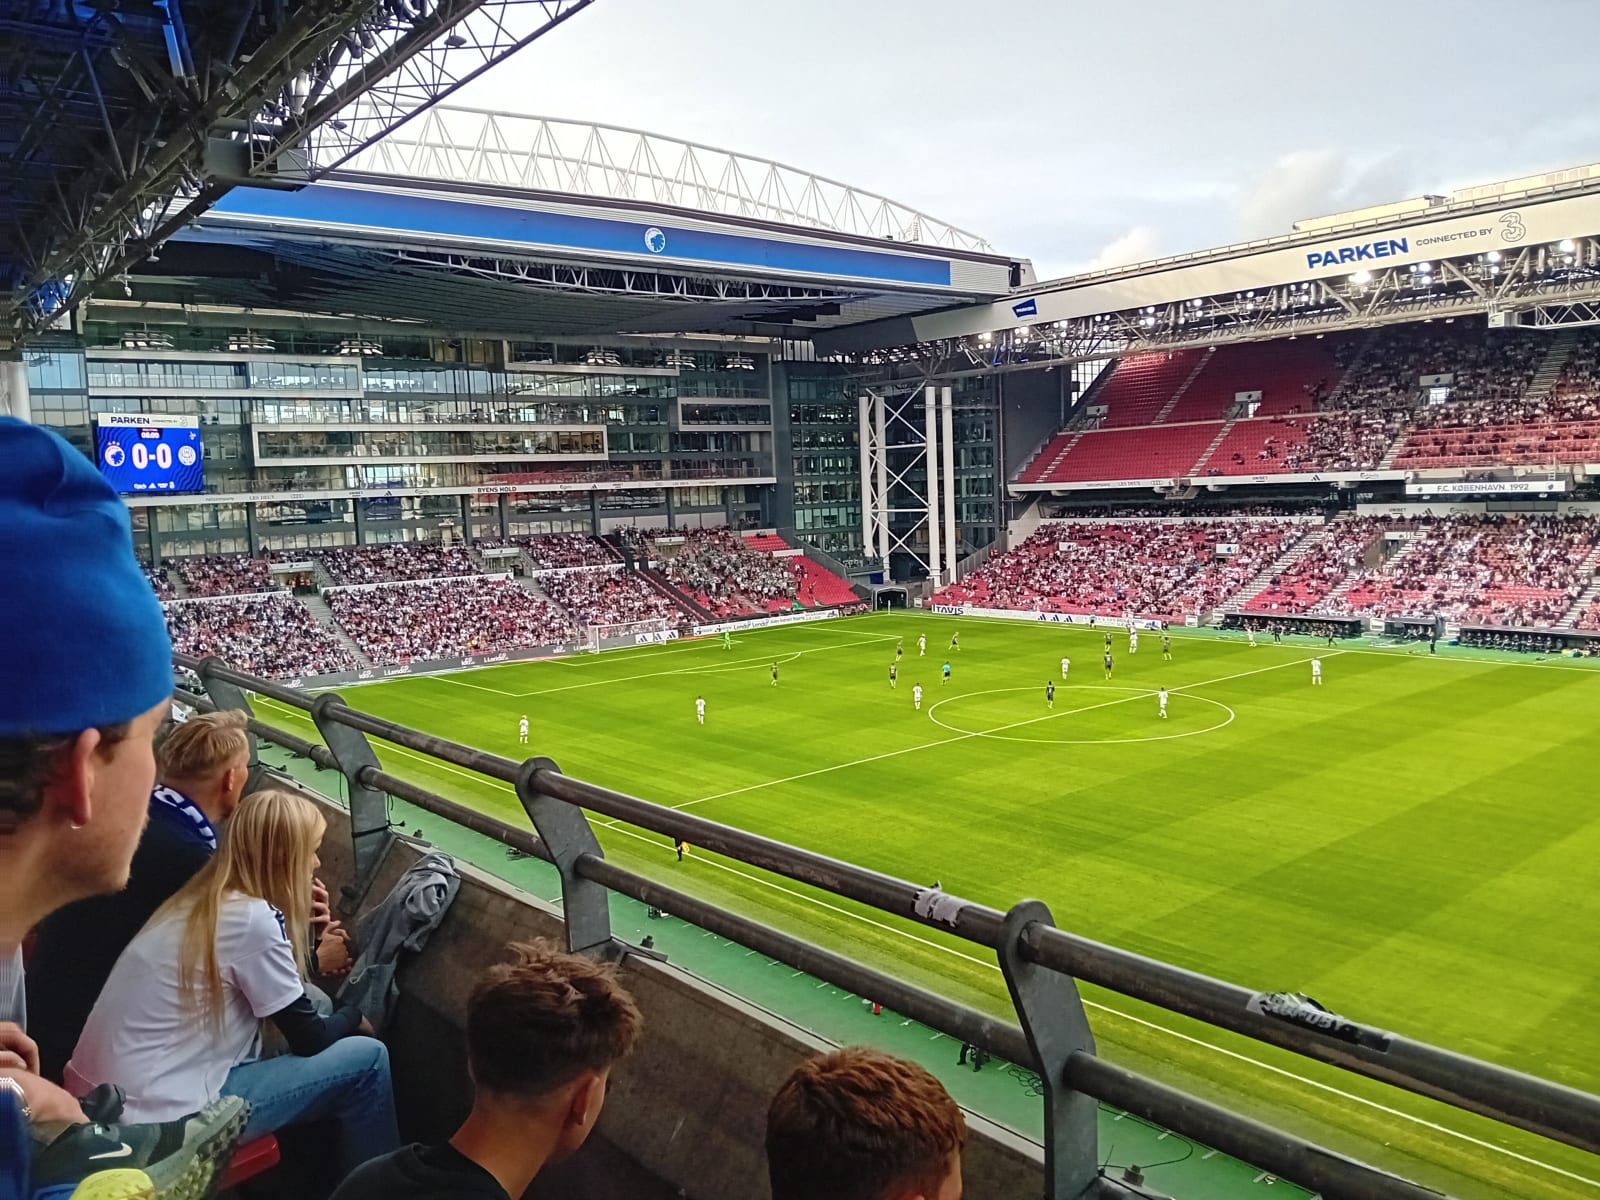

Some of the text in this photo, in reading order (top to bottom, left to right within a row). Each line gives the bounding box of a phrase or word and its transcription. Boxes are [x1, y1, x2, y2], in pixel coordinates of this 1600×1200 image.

[1306, 211, 1527, 269] PARKEN CONNECTED BY 3
[110, 416, 150, 425] PARKEN
[131, 442, 172, 469] 0-0
[1510, 483, 1529, 491] 1992
